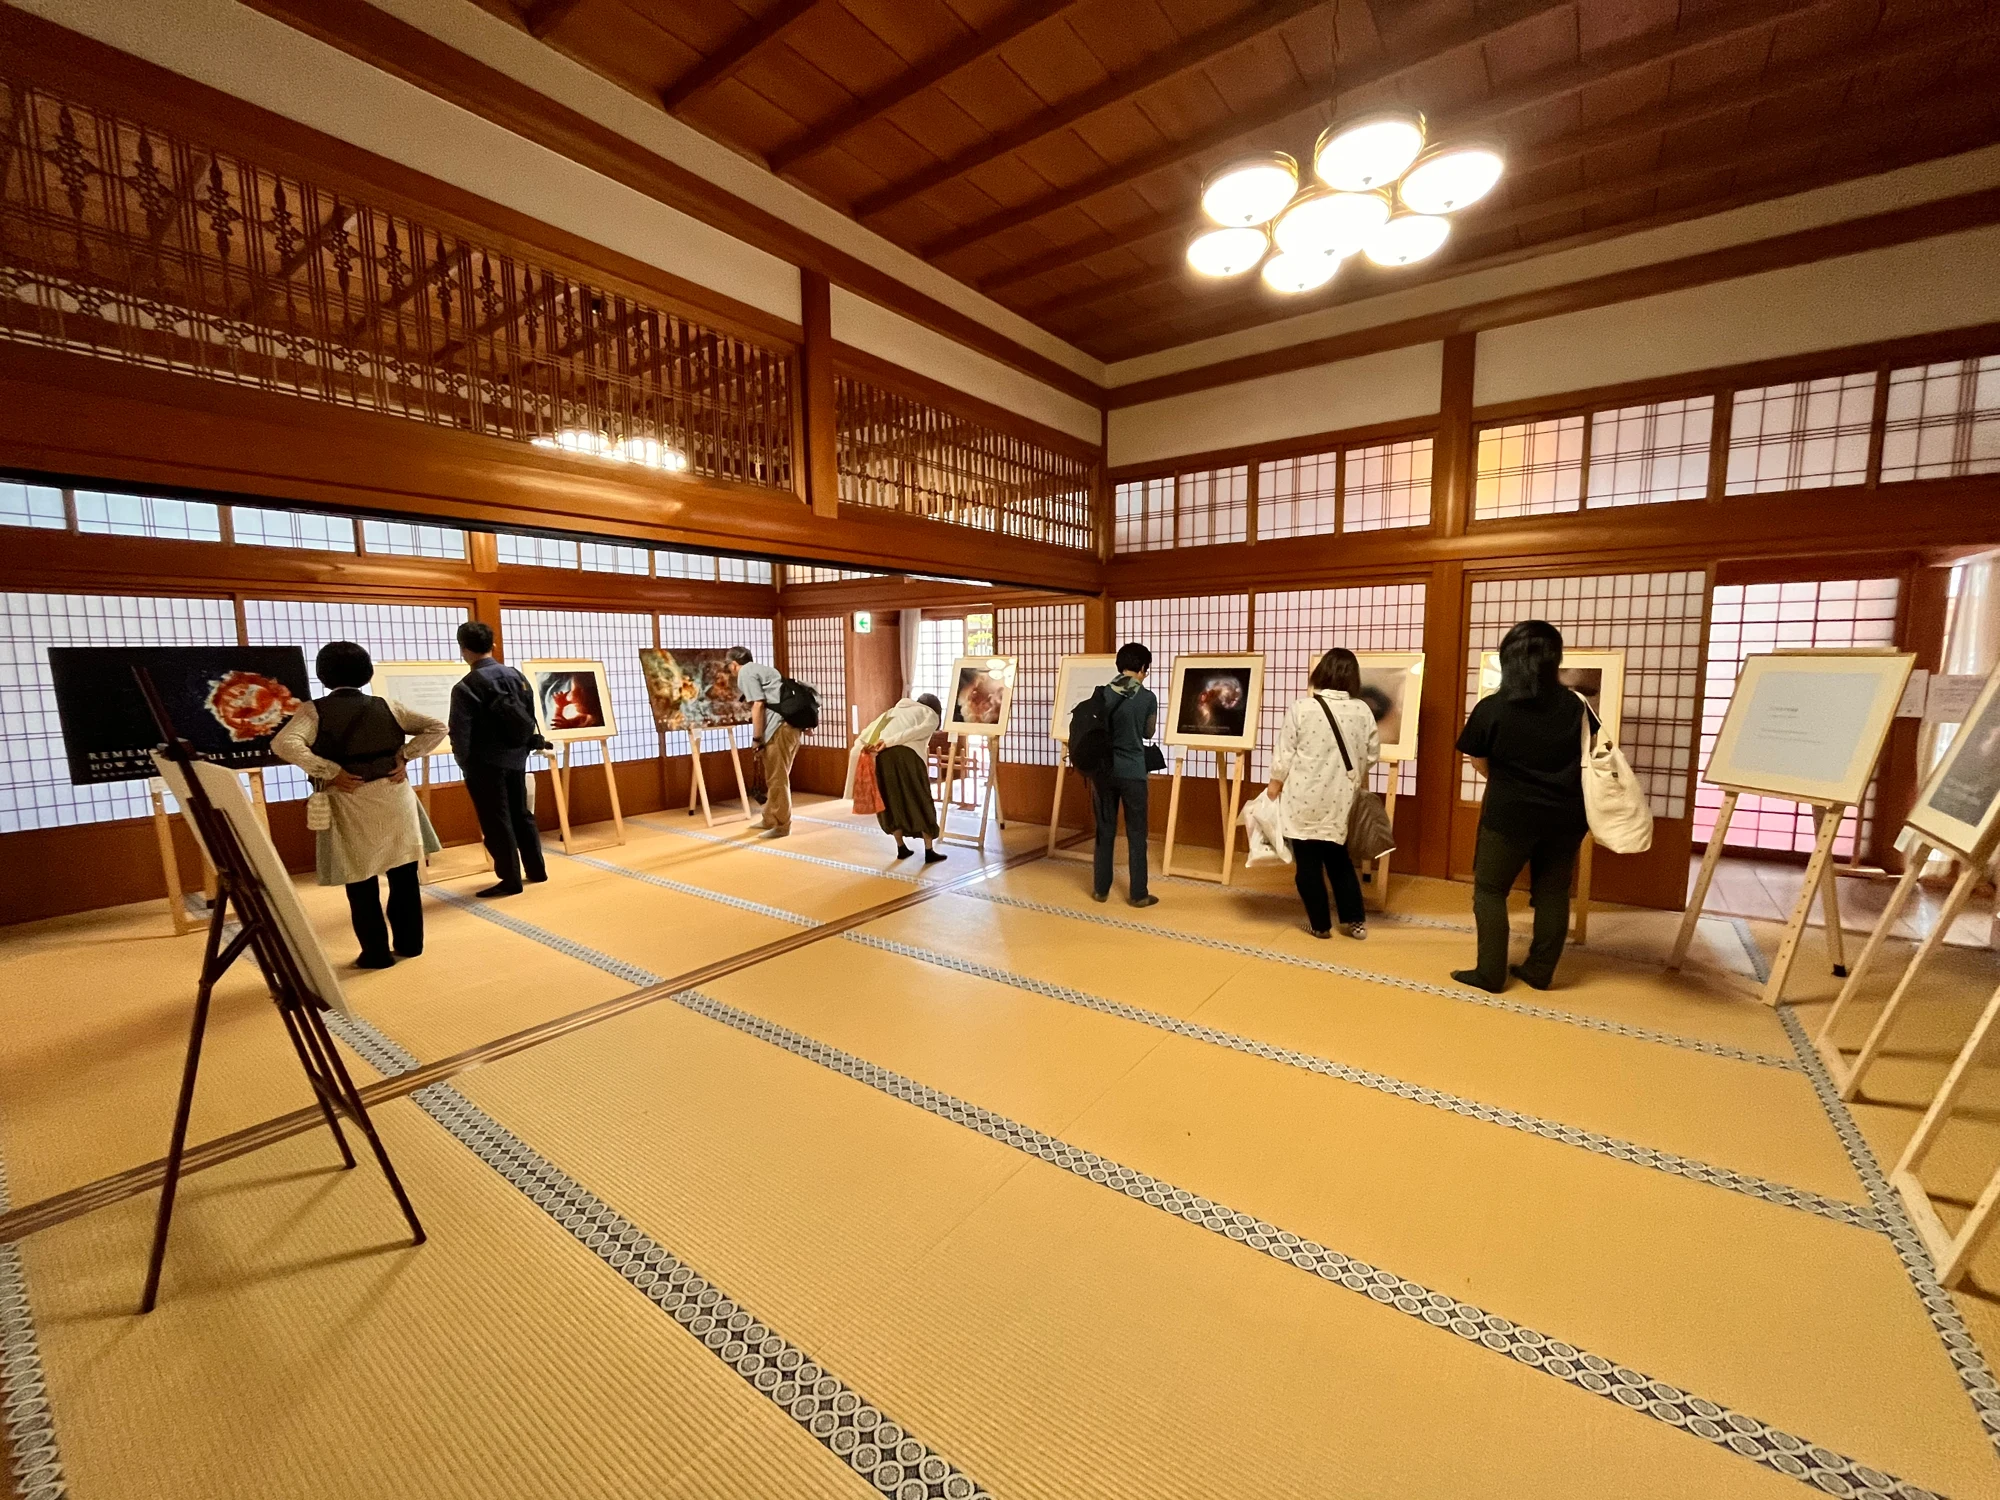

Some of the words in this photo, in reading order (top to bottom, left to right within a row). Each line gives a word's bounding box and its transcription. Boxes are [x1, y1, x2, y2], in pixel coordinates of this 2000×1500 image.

[88, 748, 149, 760] REMEM
[232, 750, 261, 759] LIFE
[90, 761, 127, 771] HOW
